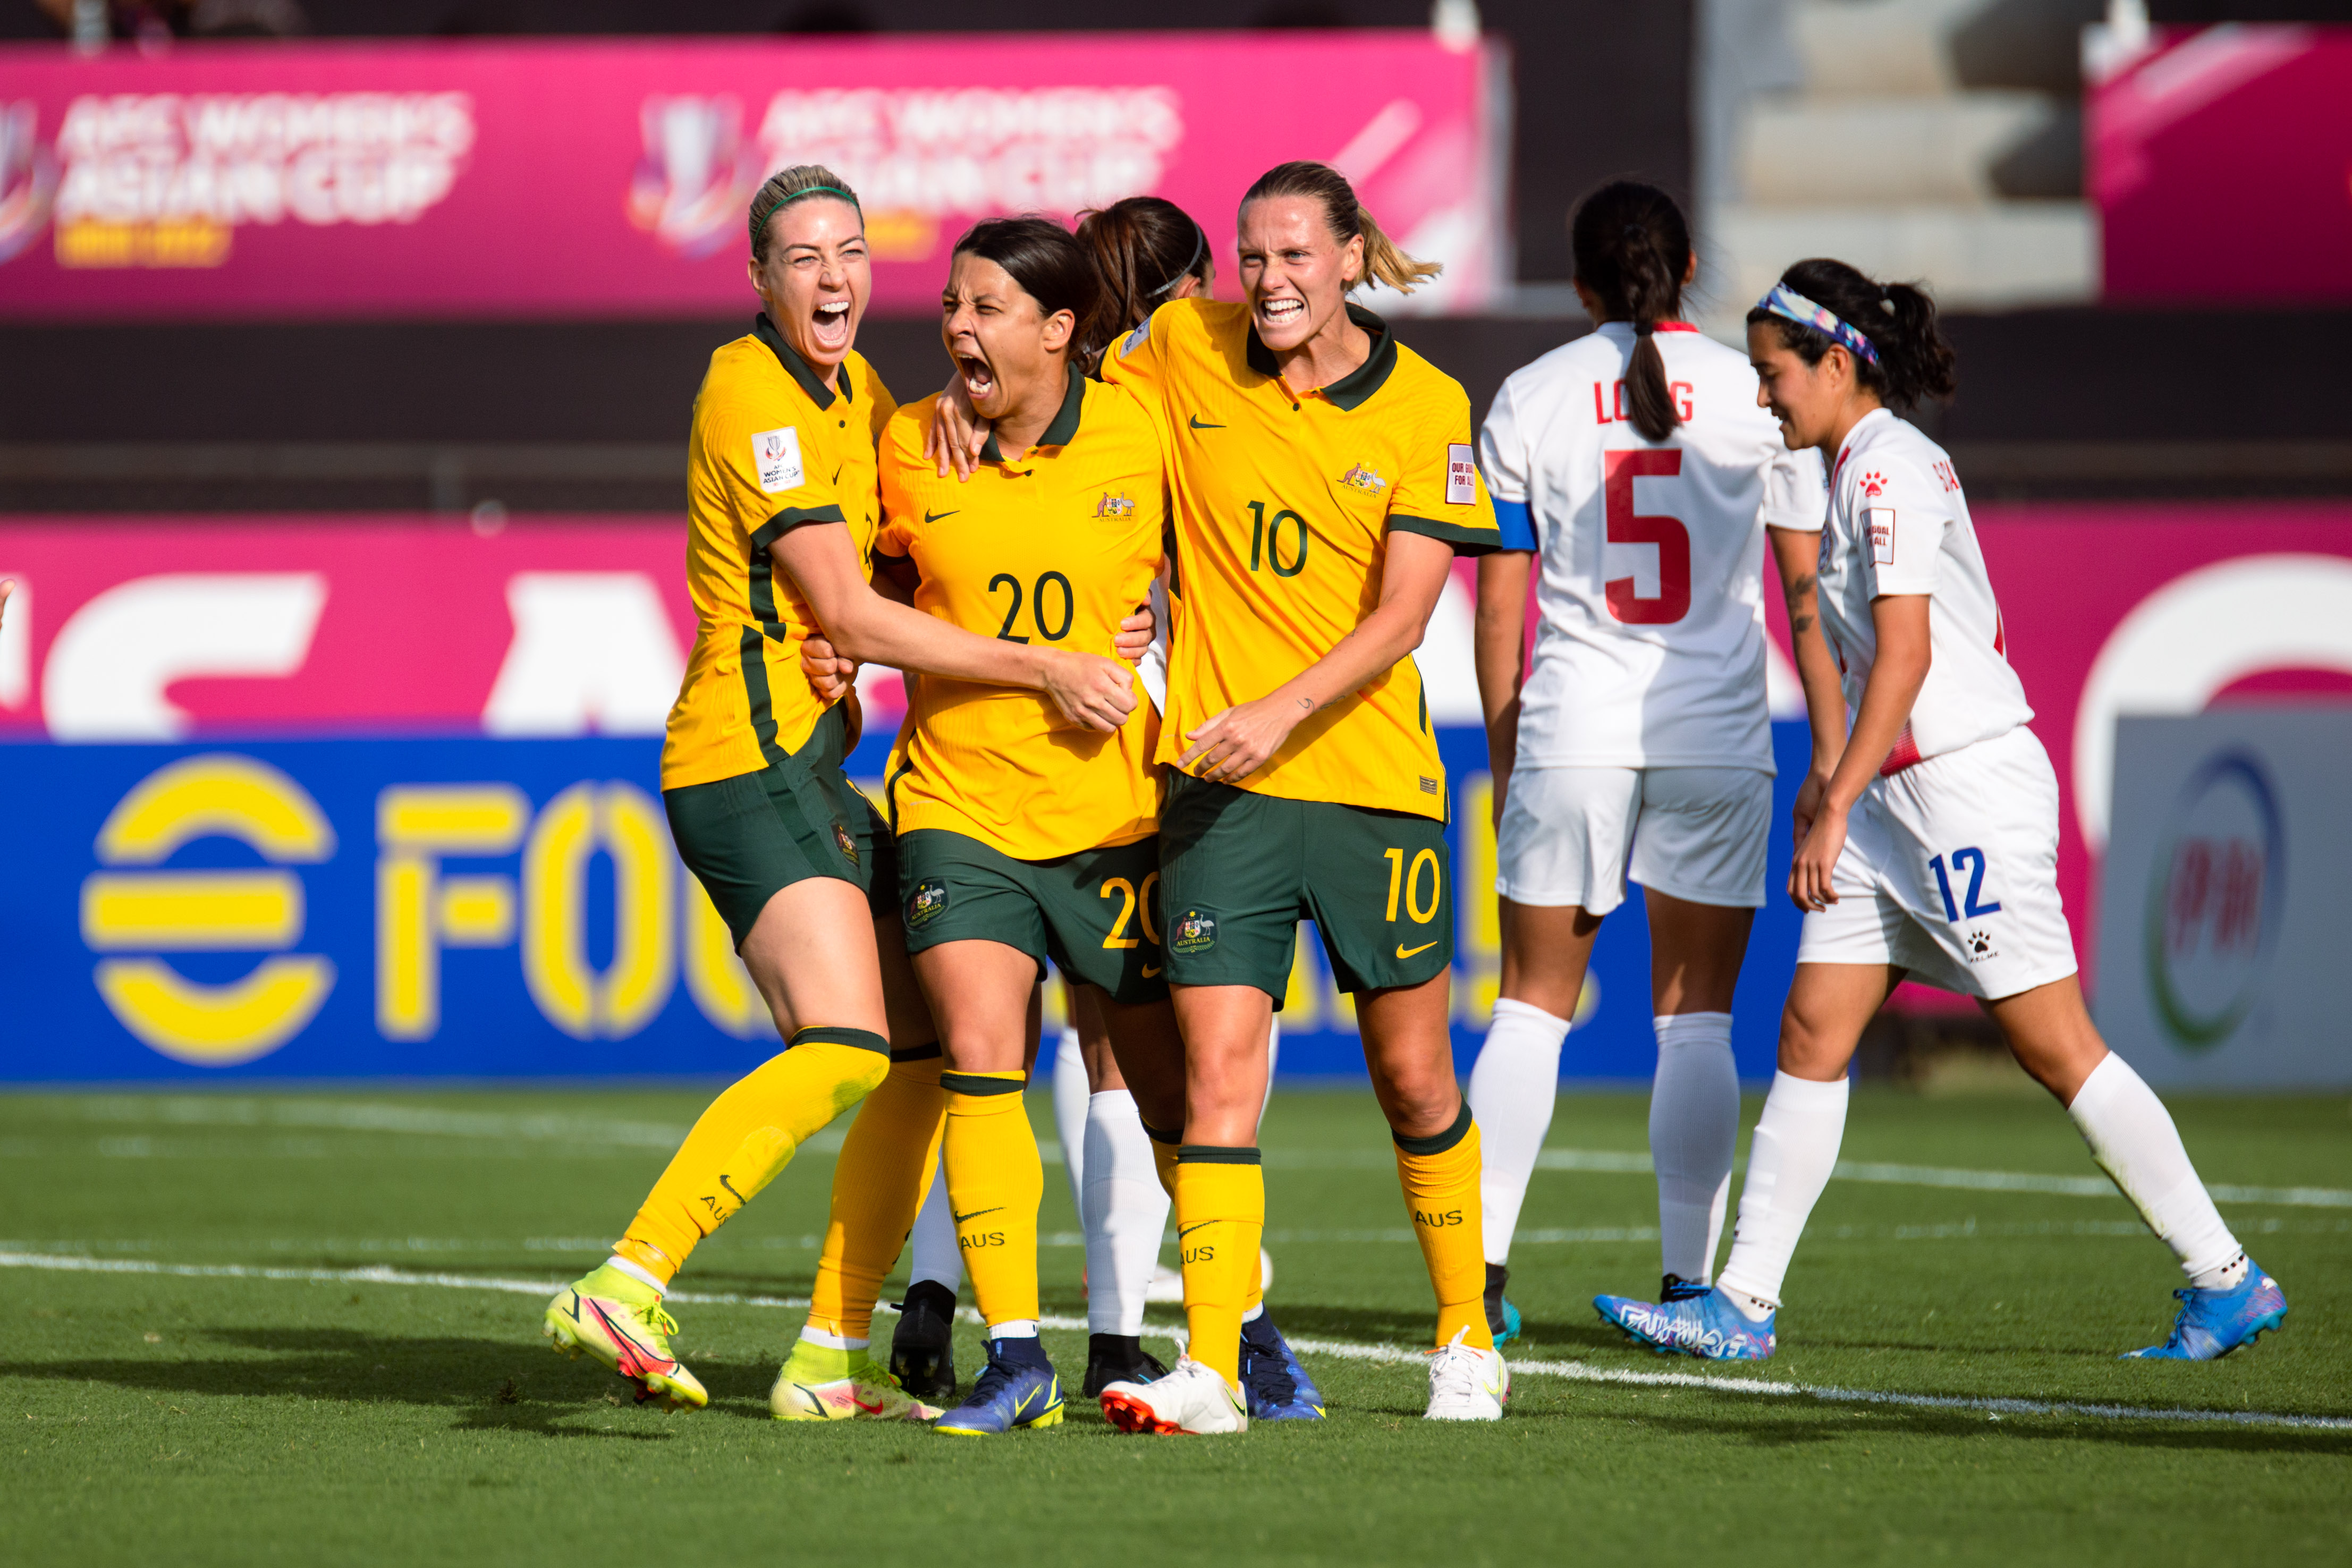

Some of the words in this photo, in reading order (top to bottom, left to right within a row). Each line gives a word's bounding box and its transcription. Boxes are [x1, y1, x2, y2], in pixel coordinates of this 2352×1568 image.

[1594, 380, 1694, 425] LOG
[1452, 462, 1464, 473] OUR
[763, 476, 784, 484] ASIAN
[1454, 474, 1466, 486] FOR
[1341, 484, 1377, 498] AUSTRALIA
[1247, 500, 1308, 578] 10
[1604, 448, 1691, 626] 5
[1872, 525, 1890, 536] GOAL
[1874, 536, 1887, 547] ALL
[988, 571, 1074, 645] 20
[1384, 848, 1440, 924] 10
[1929, 846, 2002, 923] 12
[911, 903, 942, 921] AUSTRALIA
[1176, 936, 1211, 947] AUSTRALIA
[1415, 1210, 1463, 1227] AUS
[961, 1232, 1005, 1250] AUS
